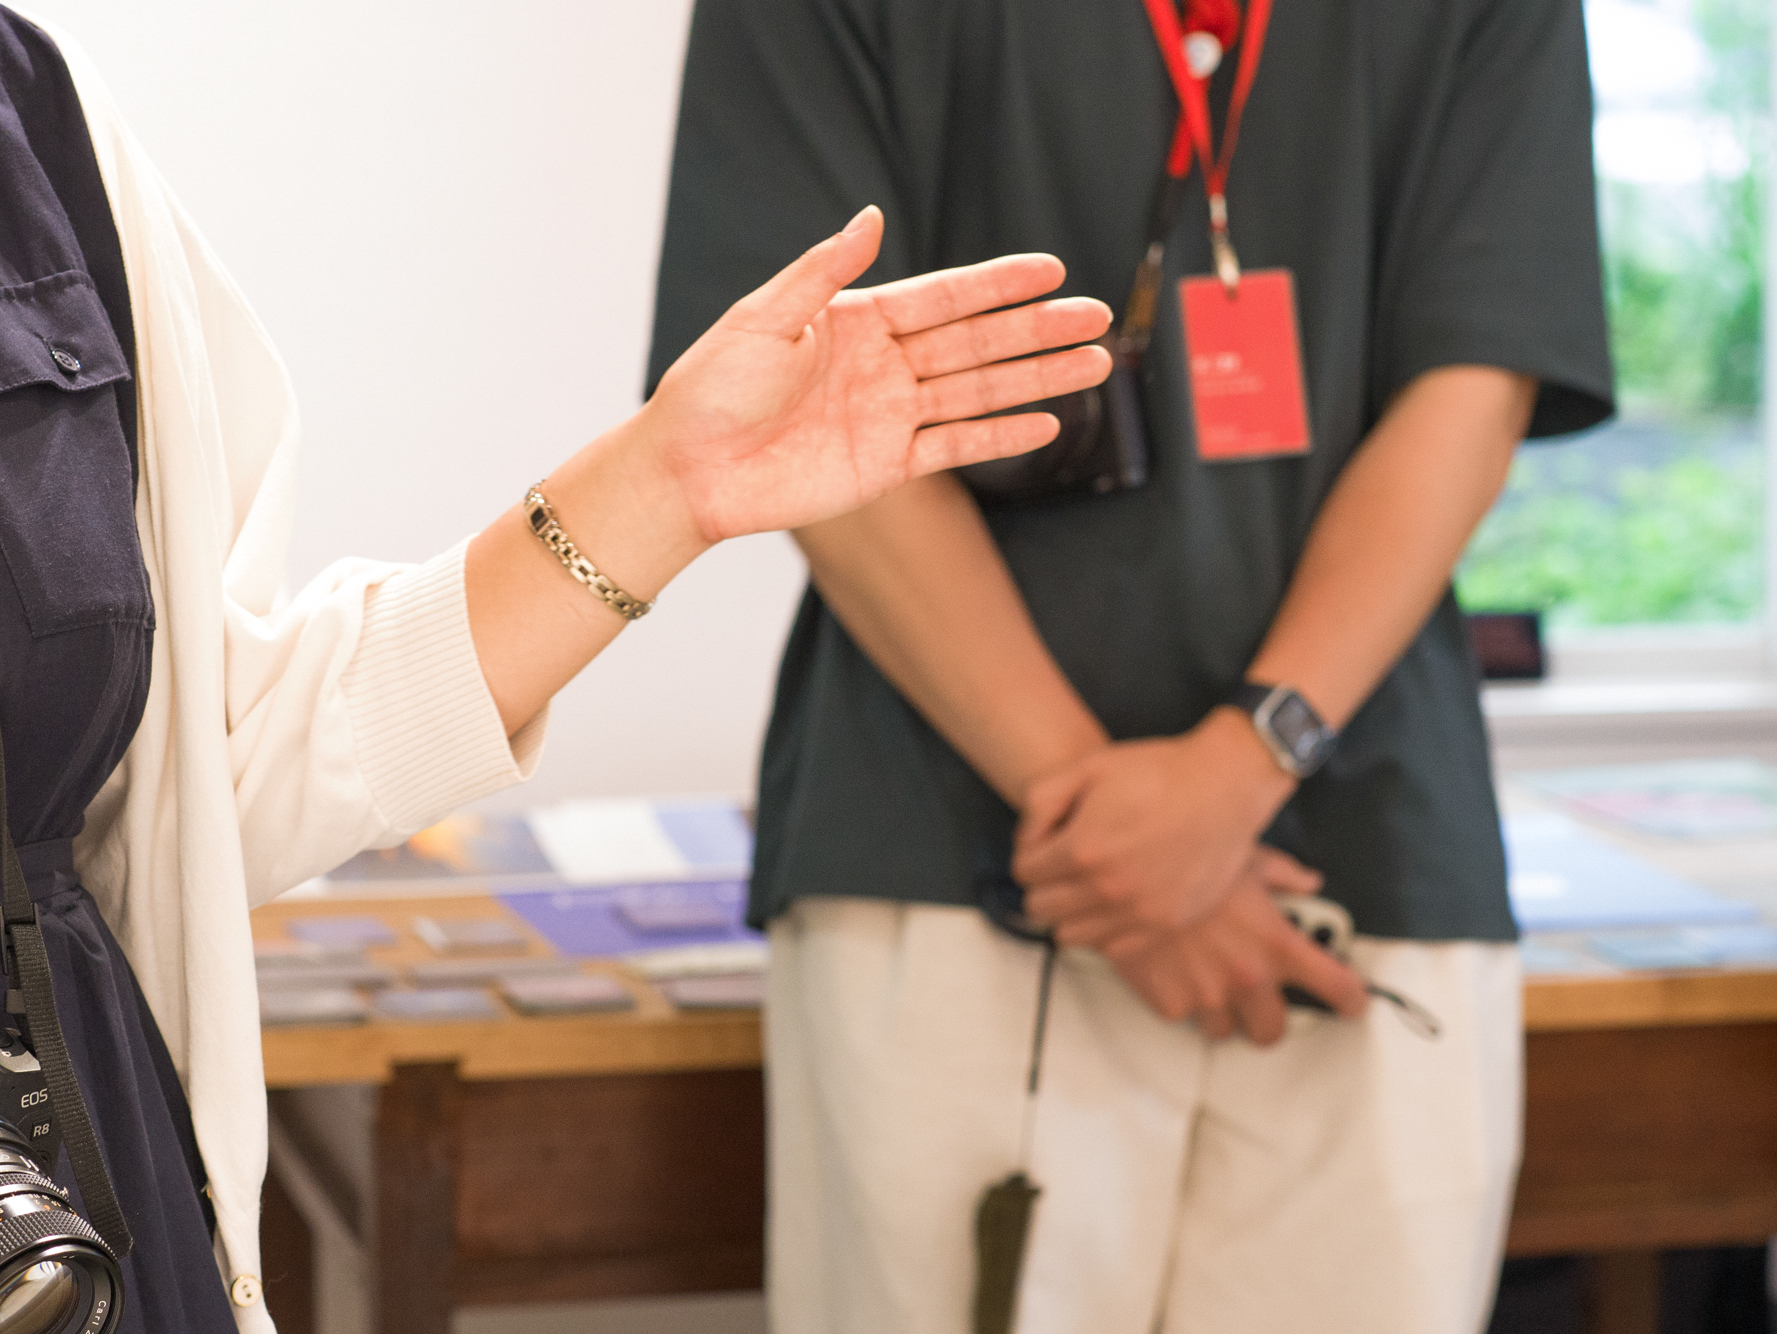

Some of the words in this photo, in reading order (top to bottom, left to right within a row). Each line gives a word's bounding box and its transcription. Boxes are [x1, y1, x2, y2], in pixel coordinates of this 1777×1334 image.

[21, 1088, 48, 1108] EOS
[33, 1123, 50, 1138] R8
[92, 1300, 107, 1326] Carl
